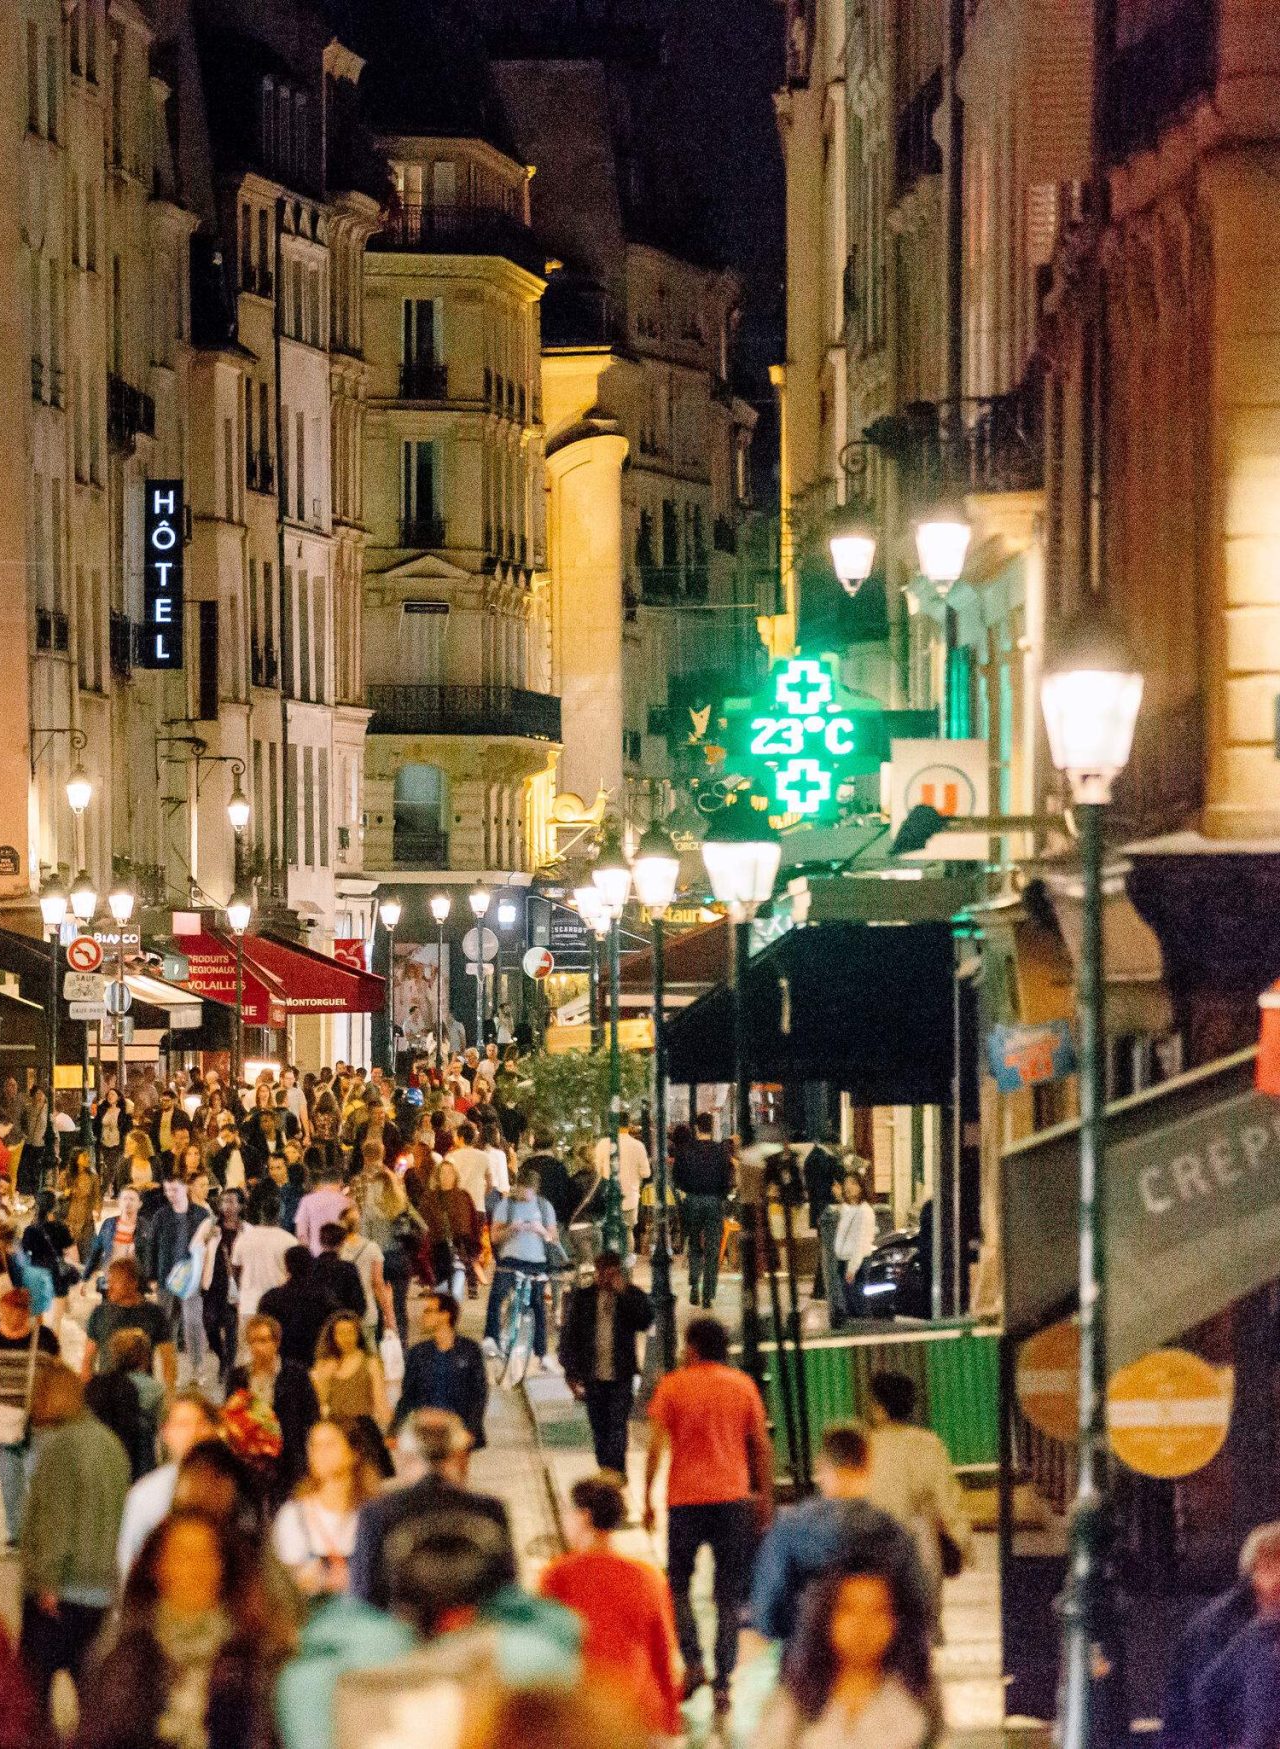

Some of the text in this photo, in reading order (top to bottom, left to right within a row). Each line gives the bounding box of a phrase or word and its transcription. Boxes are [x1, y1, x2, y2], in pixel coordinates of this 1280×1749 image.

[152, 490, 176, 659] HÔTEL
[749, 717, 855, 755] 23°C
[1139, 1115, 1280, 1214] CREP
